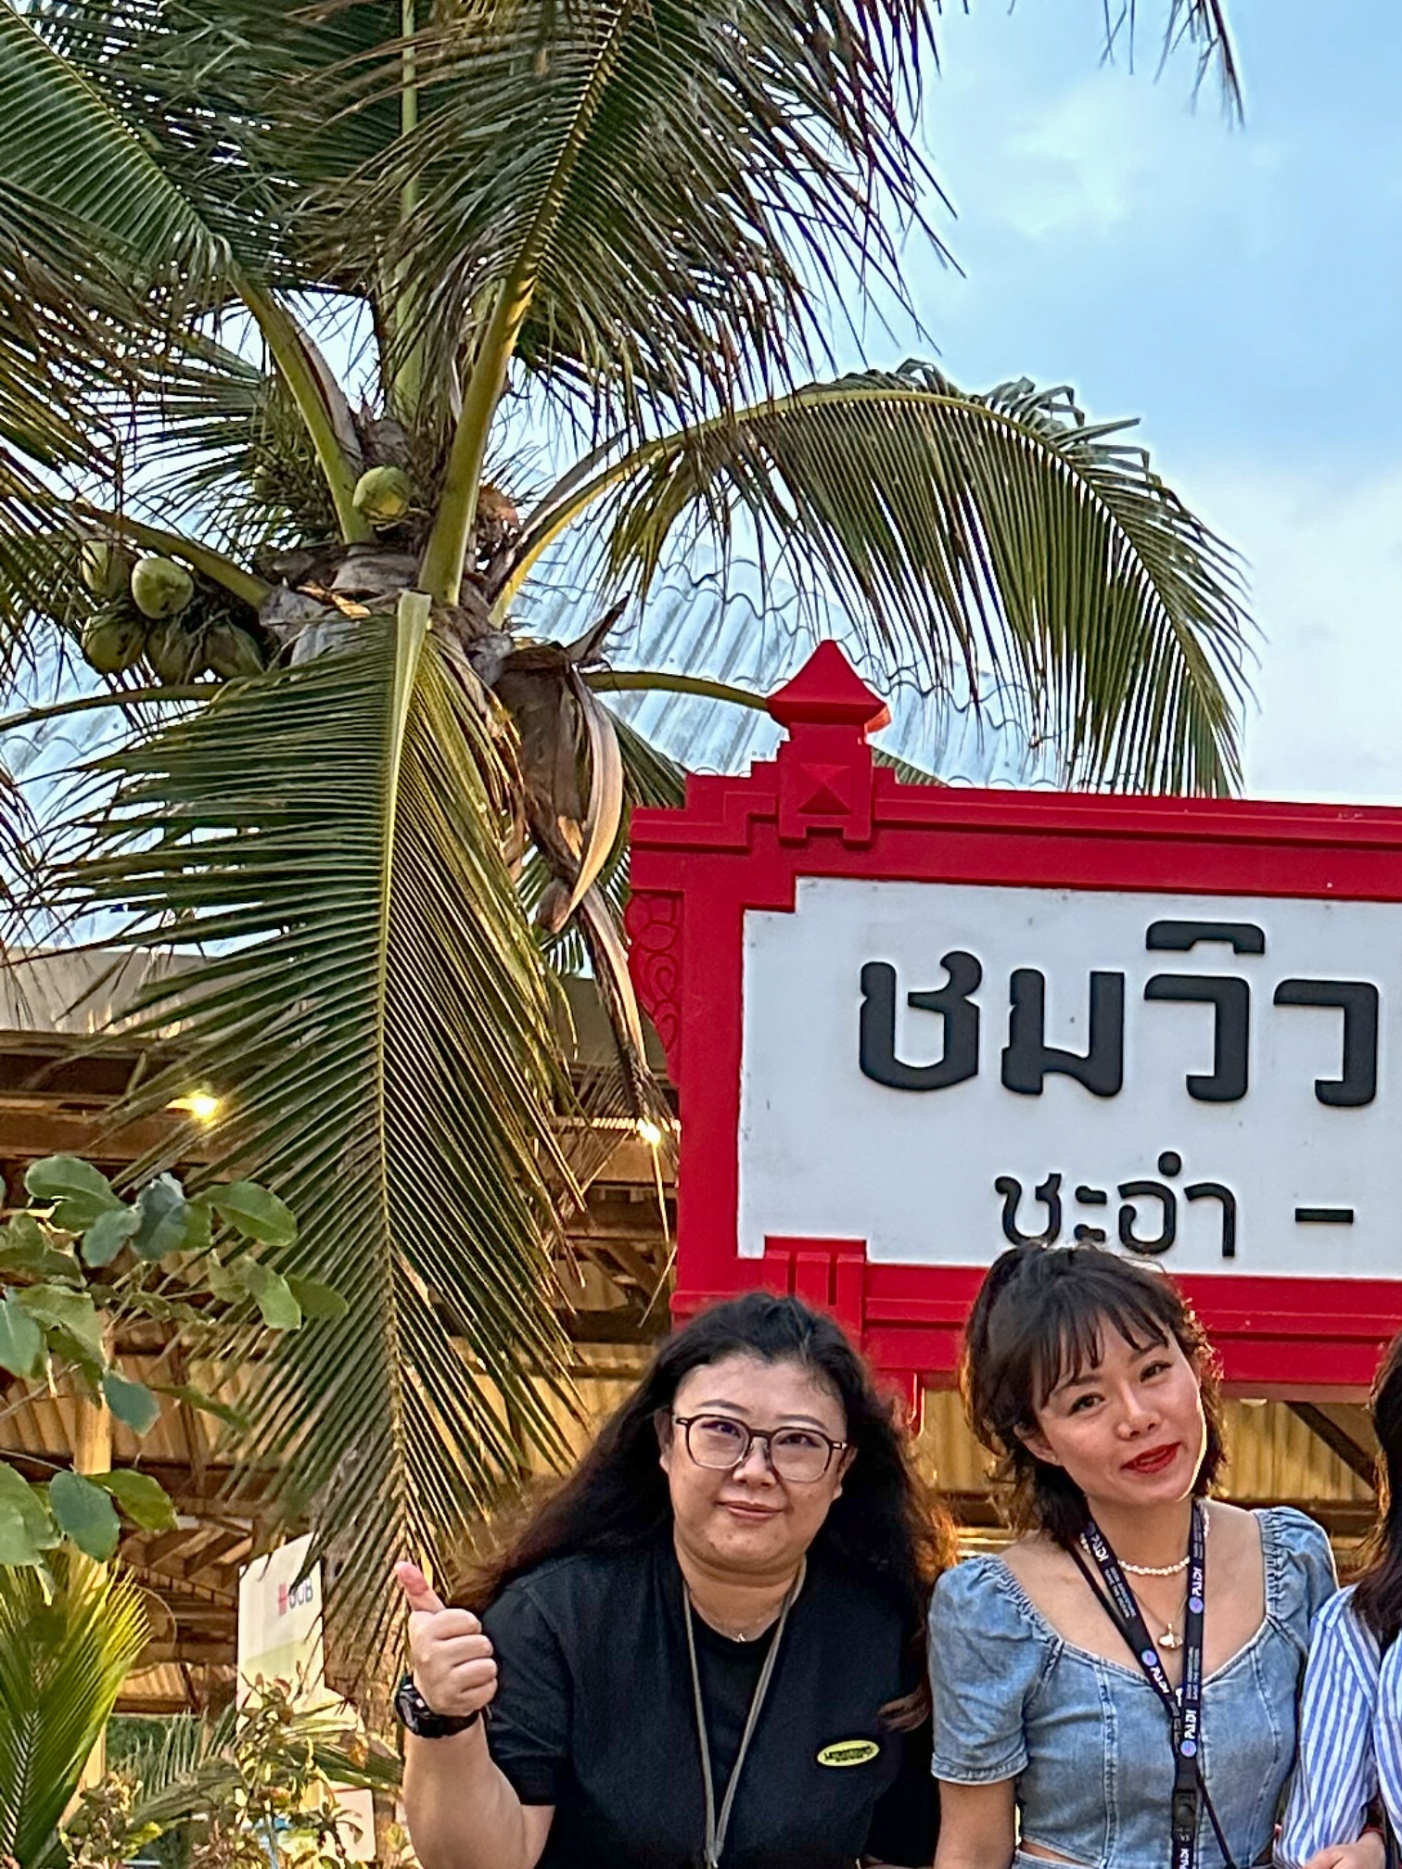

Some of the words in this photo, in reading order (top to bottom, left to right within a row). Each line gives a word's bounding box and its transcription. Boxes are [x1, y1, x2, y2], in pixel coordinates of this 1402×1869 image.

[995, 1151, 1236, 1257] ชะอำ
[1295, 1208, 1354, 1224] -
[1090, 1533, 1109, 1562] PADI
[1191, 1567, 1203, 1597] PADI
[1150, 1666, 1170, 1693] PADI
[1184, 1709, 1197, 1739] PADI
